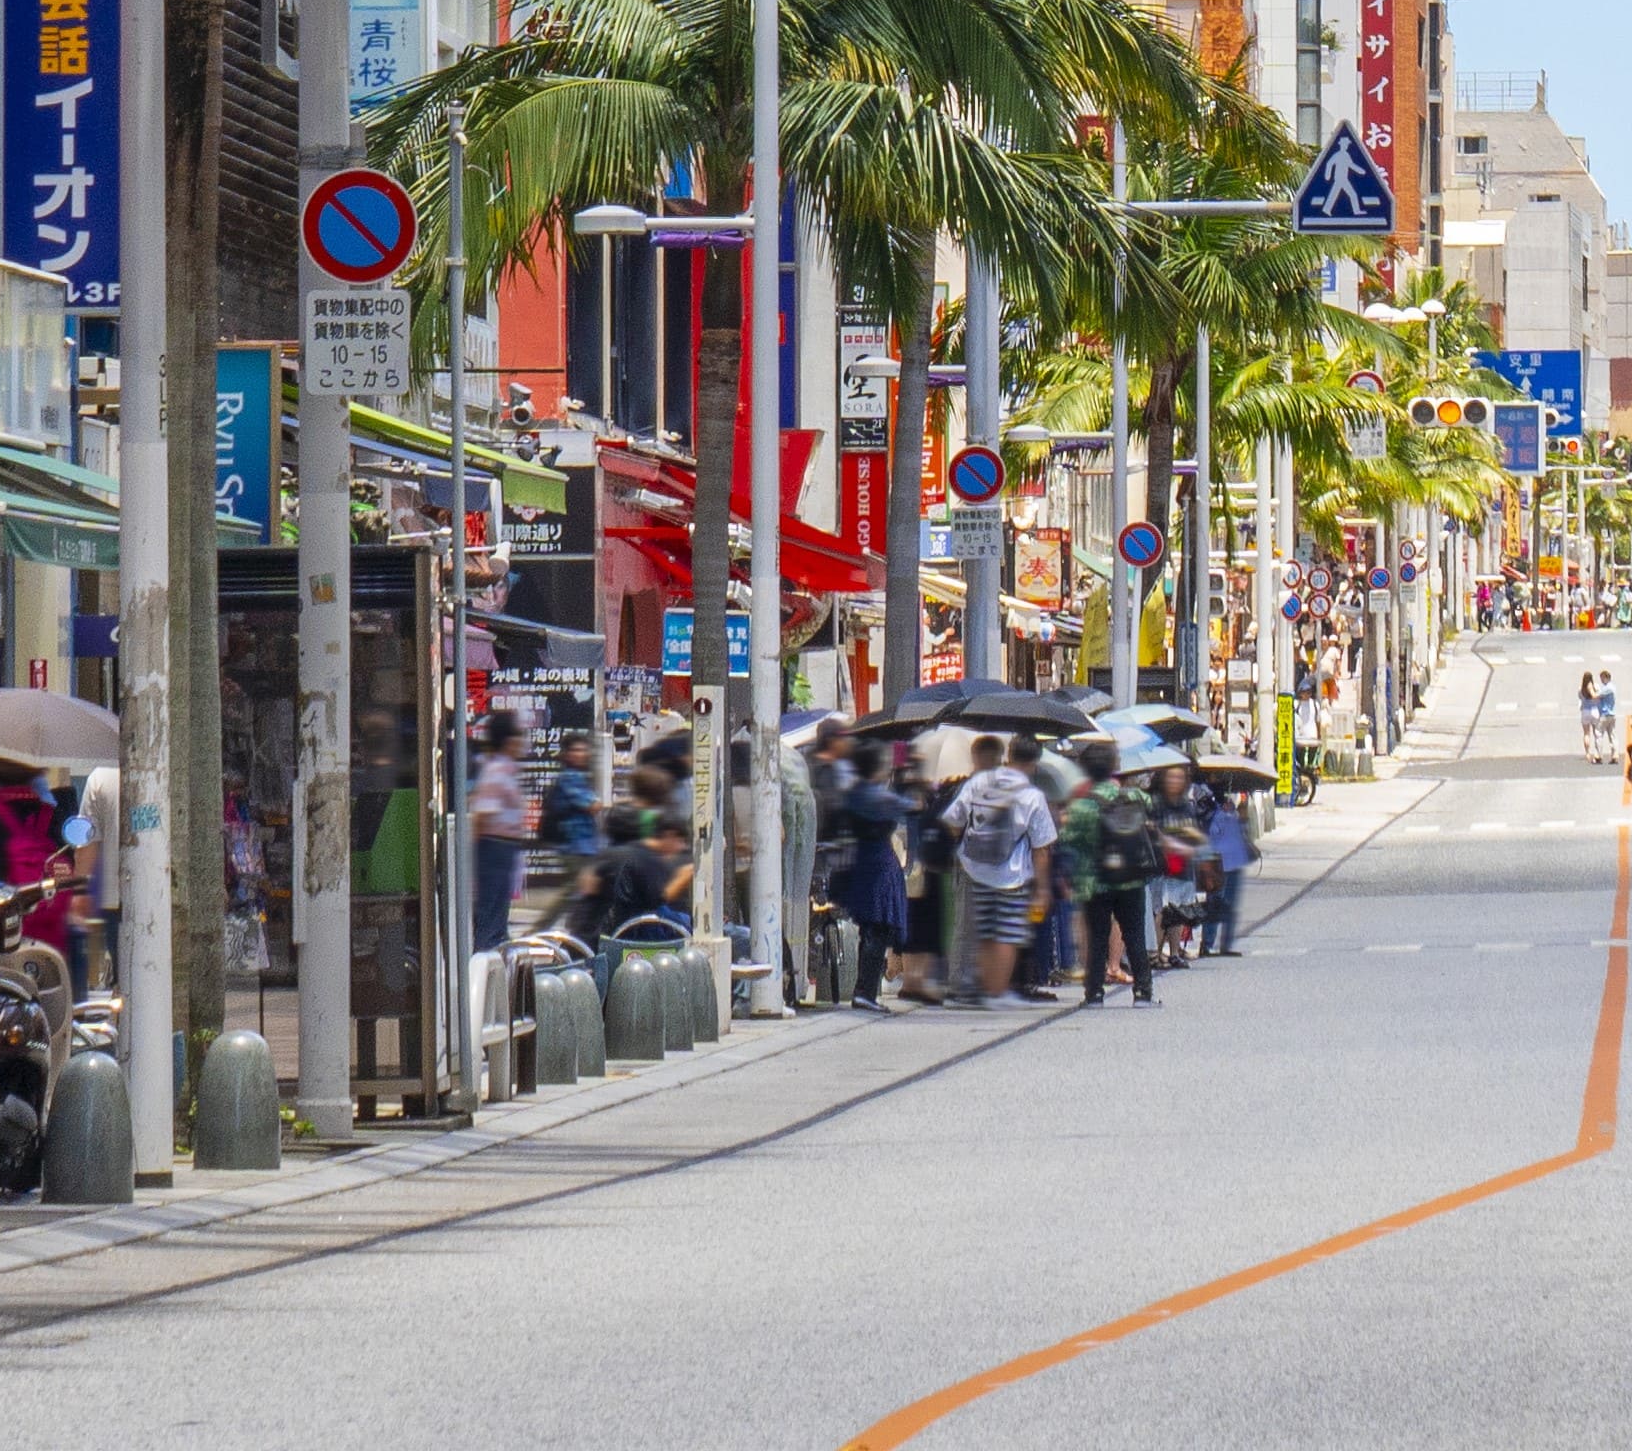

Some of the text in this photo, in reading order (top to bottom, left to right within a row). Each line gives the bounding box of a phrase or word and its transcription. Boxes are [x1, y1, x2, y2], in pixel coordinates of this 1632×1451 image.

[33, 78, 95, 272] イーオン
[313, 298, 405, 318] 貨物集配中の
[313, 321, 405, 342] 貨物車を除く
[318, 368, 401, 390] ここから
[844, 403, 884, 412] SORA
[857, 457, 871, 518] HOUSE
